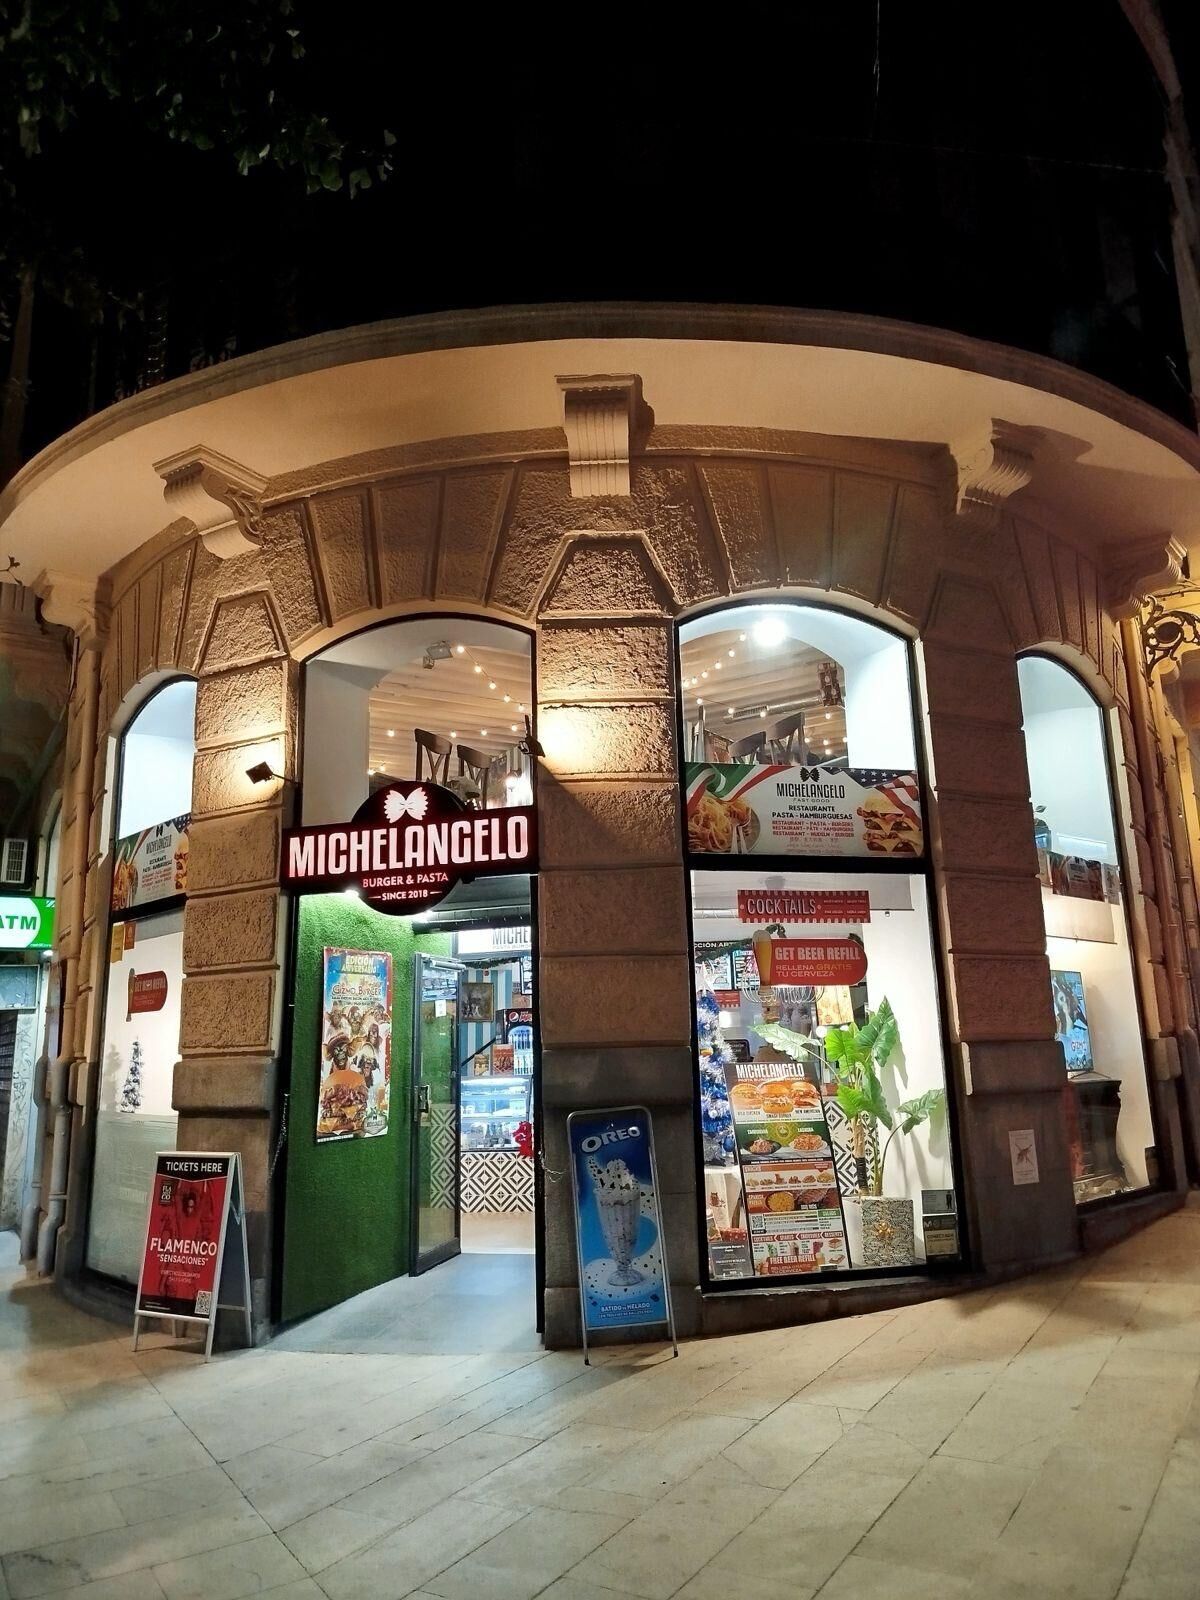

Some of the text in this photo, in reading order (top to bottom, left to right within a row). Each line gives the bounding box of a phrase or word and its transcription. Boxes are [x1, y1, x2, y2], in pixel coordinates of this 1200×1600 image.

[776, 783, 845, 799] MICHELANGELO
[799, 812, 853, 820] HAMBURGUESAS
[288, 815, 529, 878] MICHELANGELO
[362, 872, 449, 889] BURGER & PASTA
[381, 889, 428, 901] SINCE 2018
[747, 898, 817, 915] COCKTAILS
[775, 947, 861, 961] GET BEER REFILL
[815, 963, 852, 971] GRATIS
[735, 1063, 805, 1079] MICHELANGELO
[581, 1126, 641, 1153] OREO
[165, 1161, 223, 1173] TICKETS HERE
[150, 1237, 217, 1256] FLAMENCO
[157, 1253, 209, 1266] "SENSACIONES"
[770, 1256, 783, 1264] FREE
[783, 1255, 798, 1263] BEER
